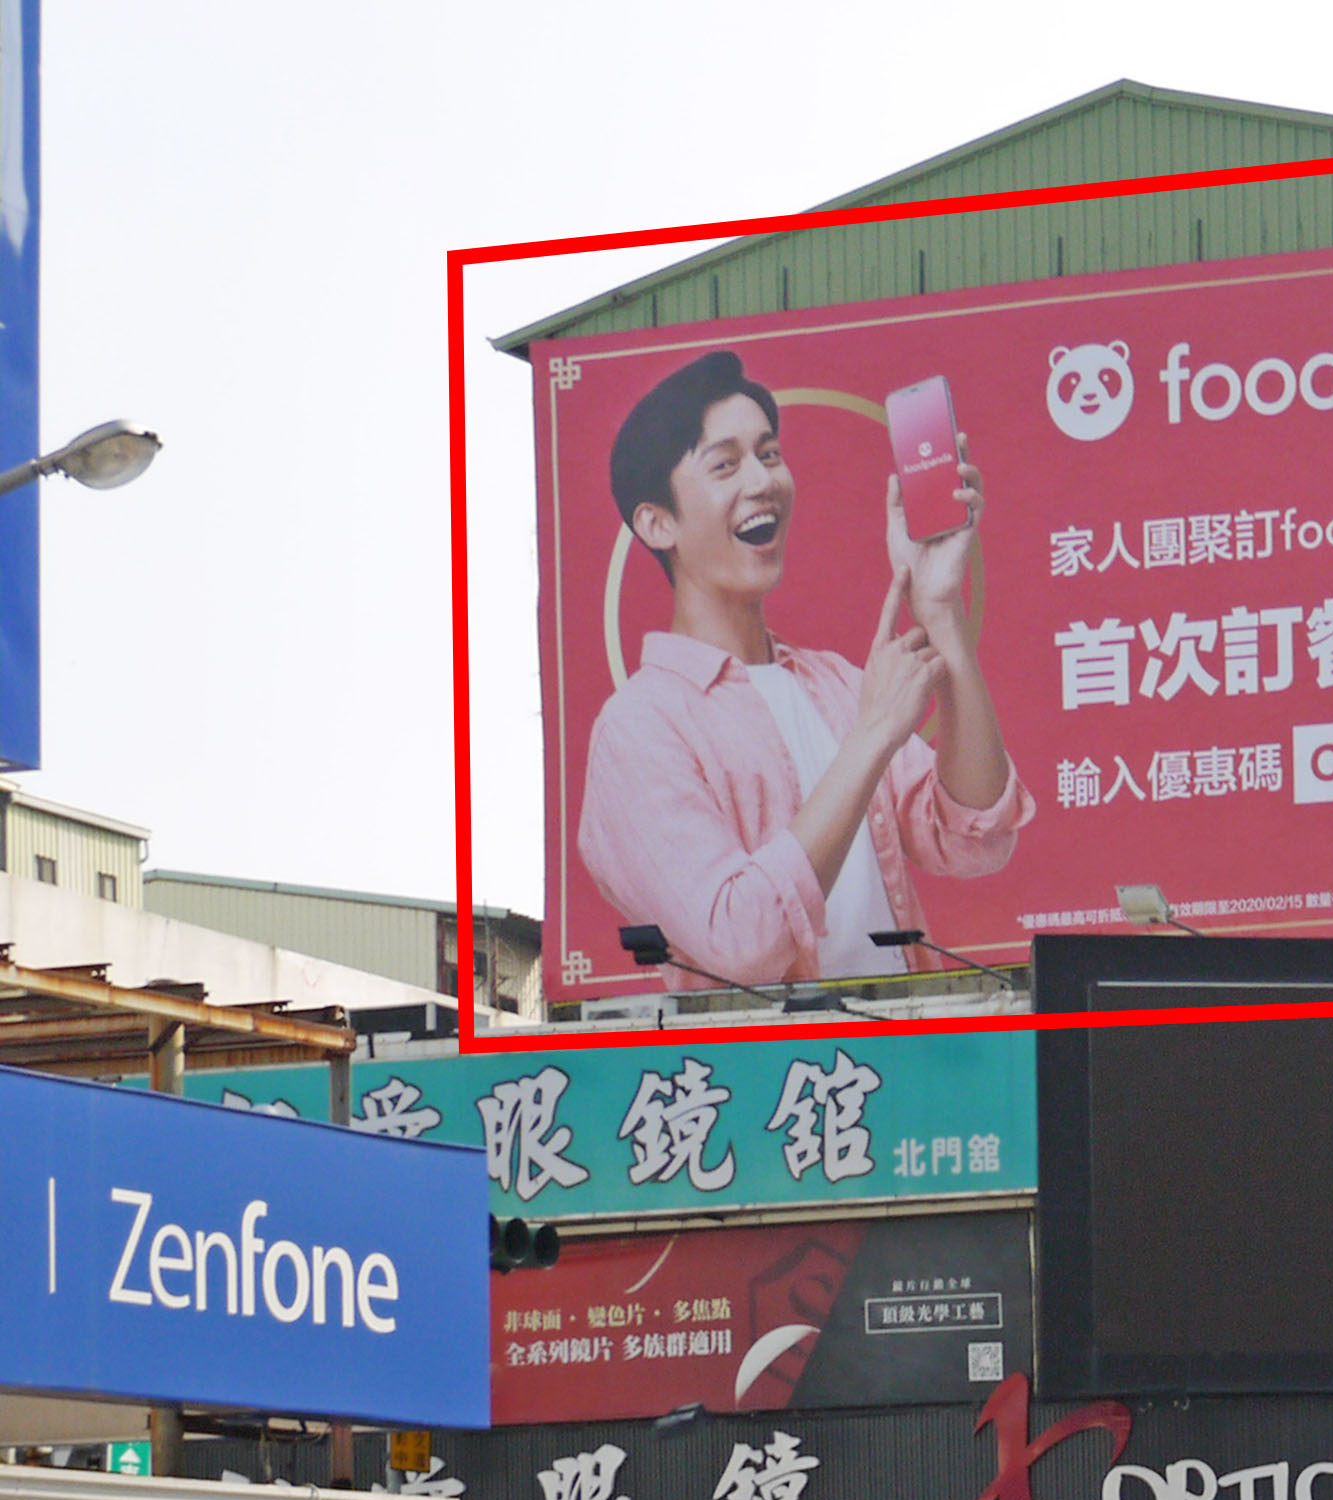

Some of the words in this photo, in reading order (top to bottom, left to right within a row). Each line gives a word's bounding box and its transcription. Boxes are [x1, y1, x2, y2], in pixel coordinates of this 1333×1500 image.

[1056, 742, 1284, 809] 輸入優惠碼
[108, 1187, 399, 1334] Zenfone
